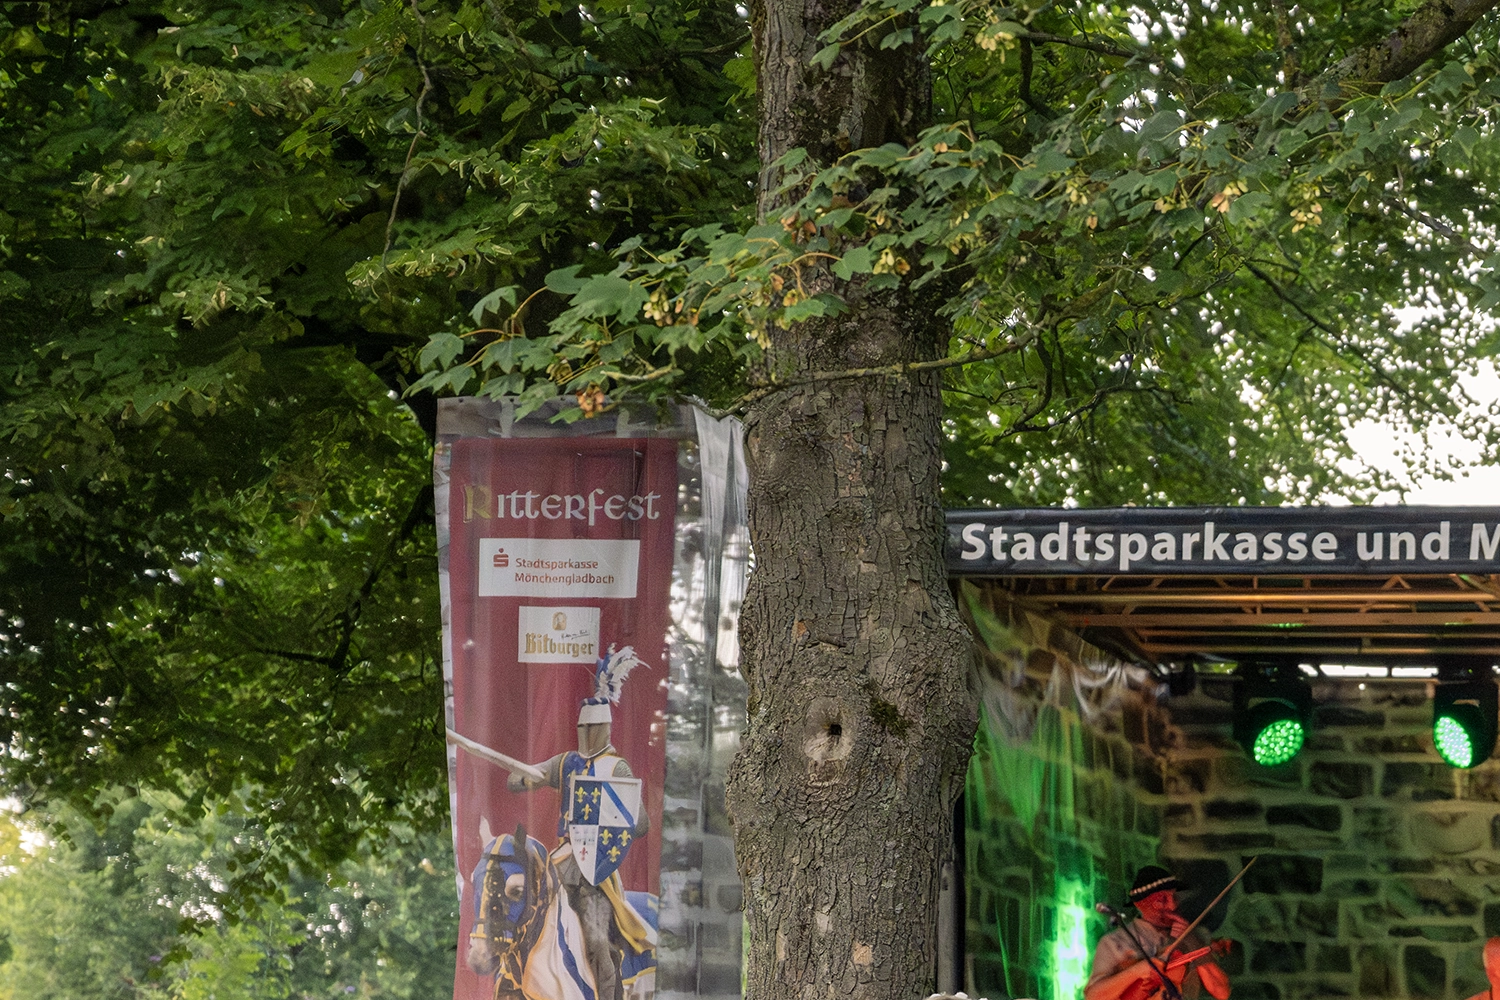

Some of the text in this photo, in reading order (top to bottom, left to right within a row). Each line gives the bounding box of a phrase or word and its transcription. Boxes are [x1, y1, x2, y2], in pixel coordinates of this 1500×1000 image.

[961, 520, 1339, 570] Stadtsparkasse
[1356, 521, 1451, 561] und
[515, 557, 599, 570] Stadtsparkasse
[514, 572, 615, 586] Mönchengladbach
[524, 632, 594, 658] Bitburger
